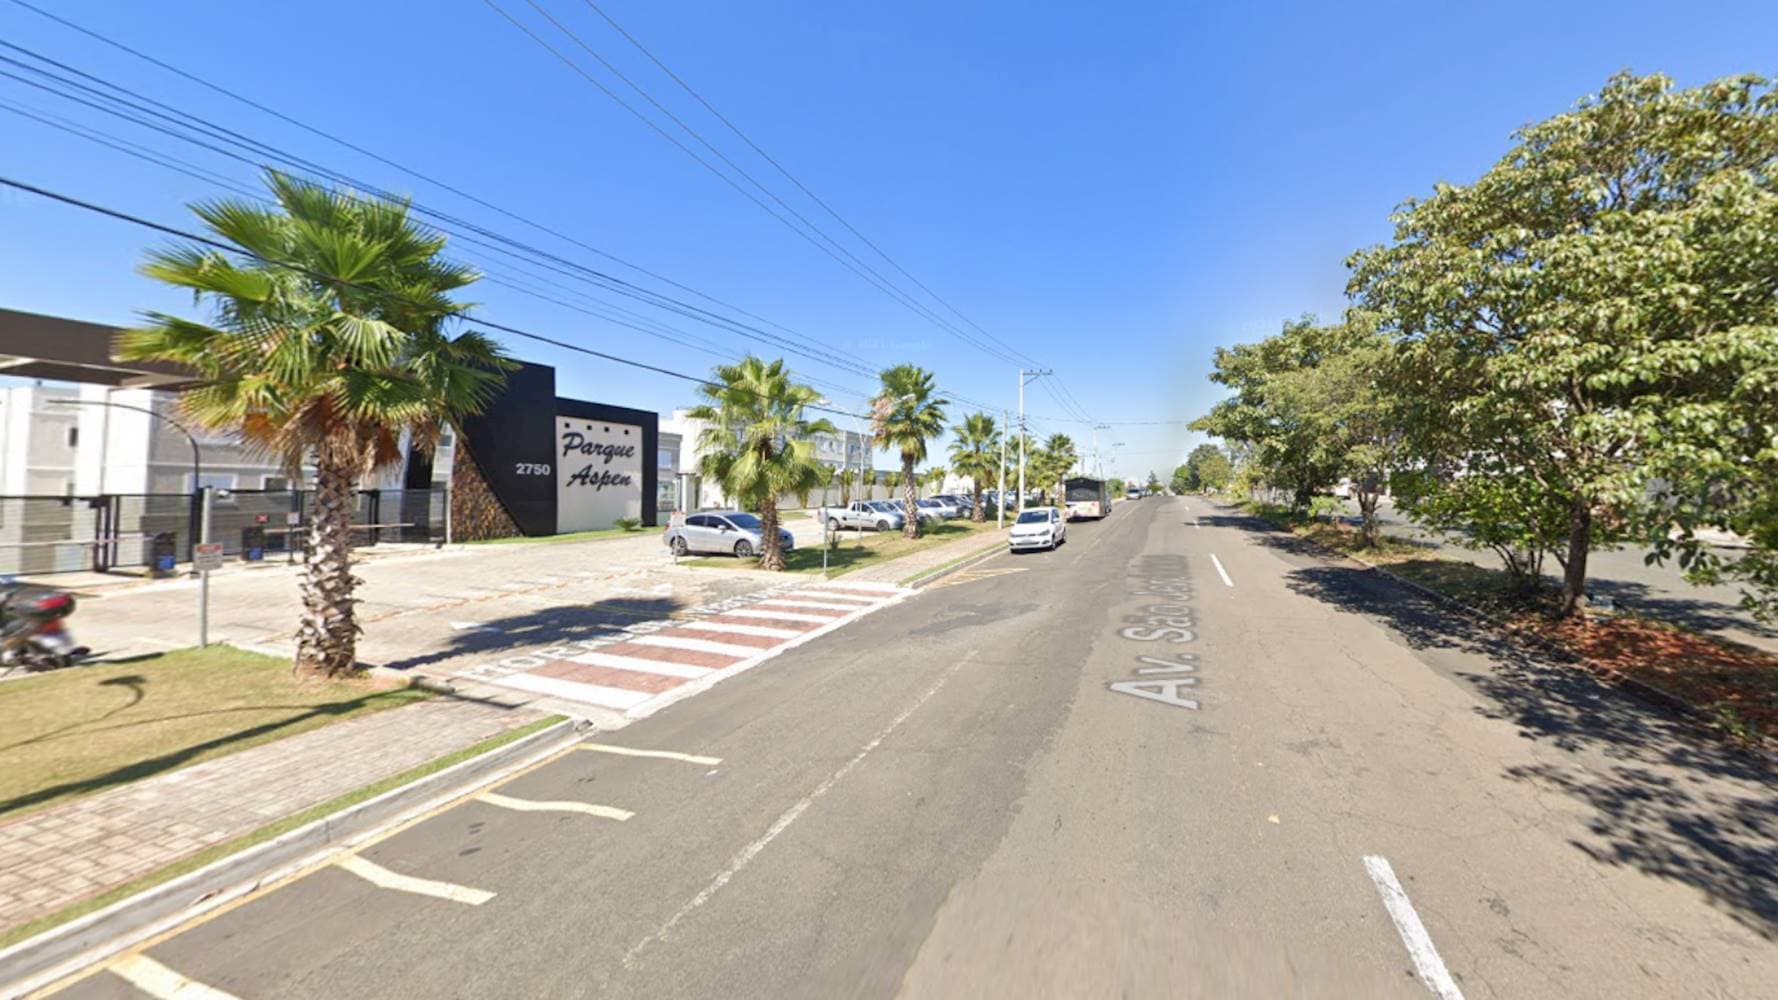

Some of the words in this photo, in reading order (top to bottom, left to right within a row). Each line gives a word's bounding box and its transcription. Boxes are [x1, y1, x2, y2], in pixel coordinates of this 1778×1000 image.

[562, 432, 635, 464] Parque
[515, 463, 551, 476] 2750
[566, 464, 631, 491] Aspen
